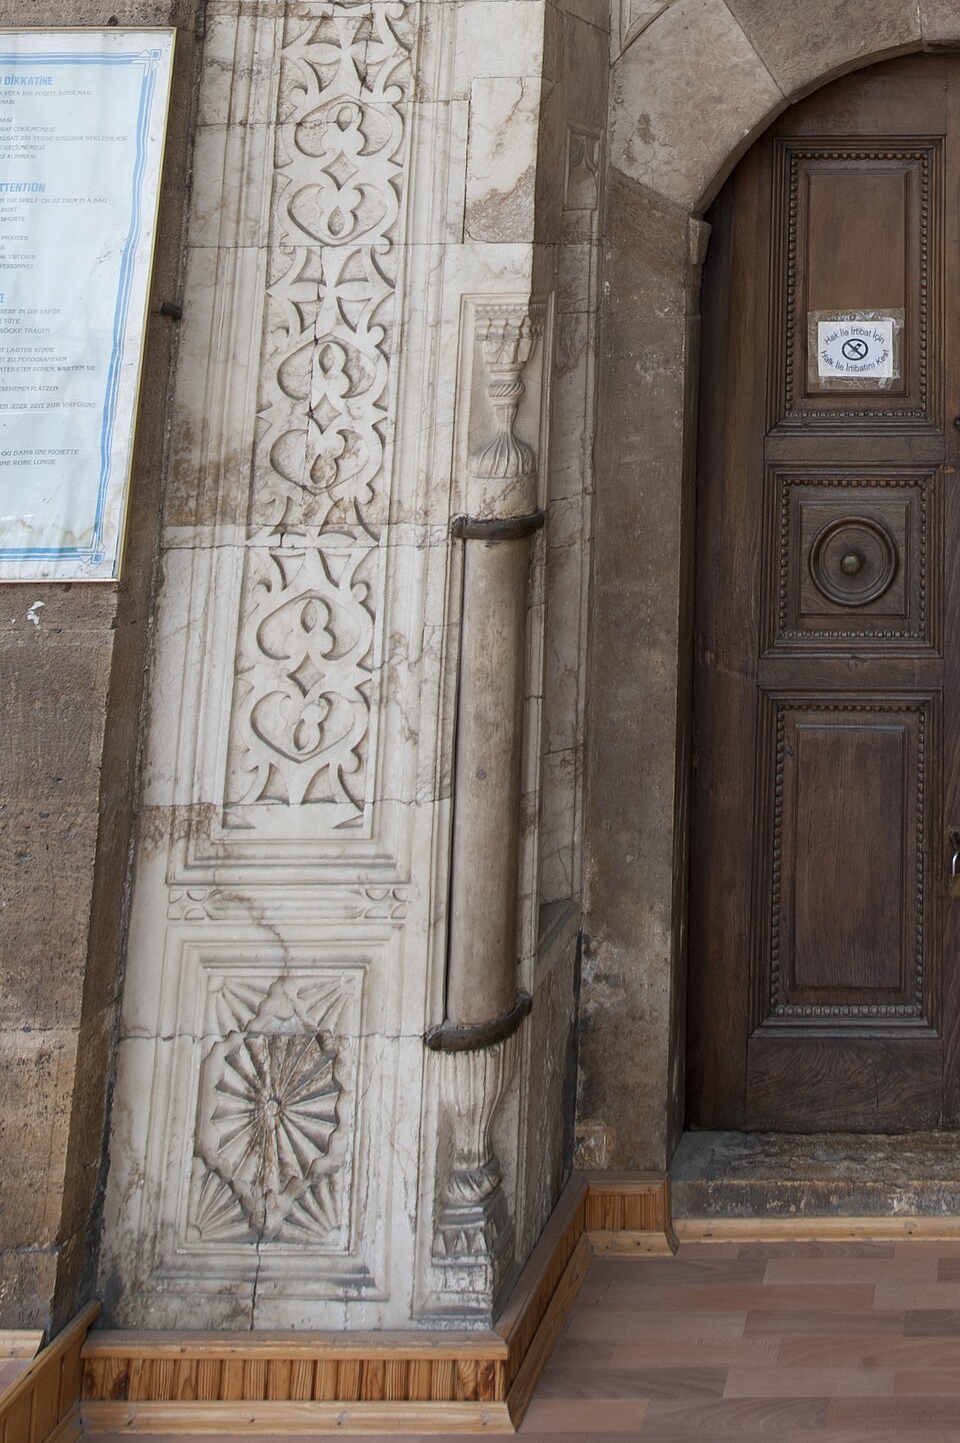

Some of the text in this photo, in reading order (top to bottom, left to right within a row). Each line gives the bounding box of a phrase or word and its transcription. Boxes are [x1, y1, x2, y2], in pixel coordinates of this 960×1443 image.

[4, 75, 54, 86] DİKKATİNE
[824, 332, 840, 346] Hak
[850, 326, 872, 337] İrtibat
[820, 350, 834, 366] Halk
